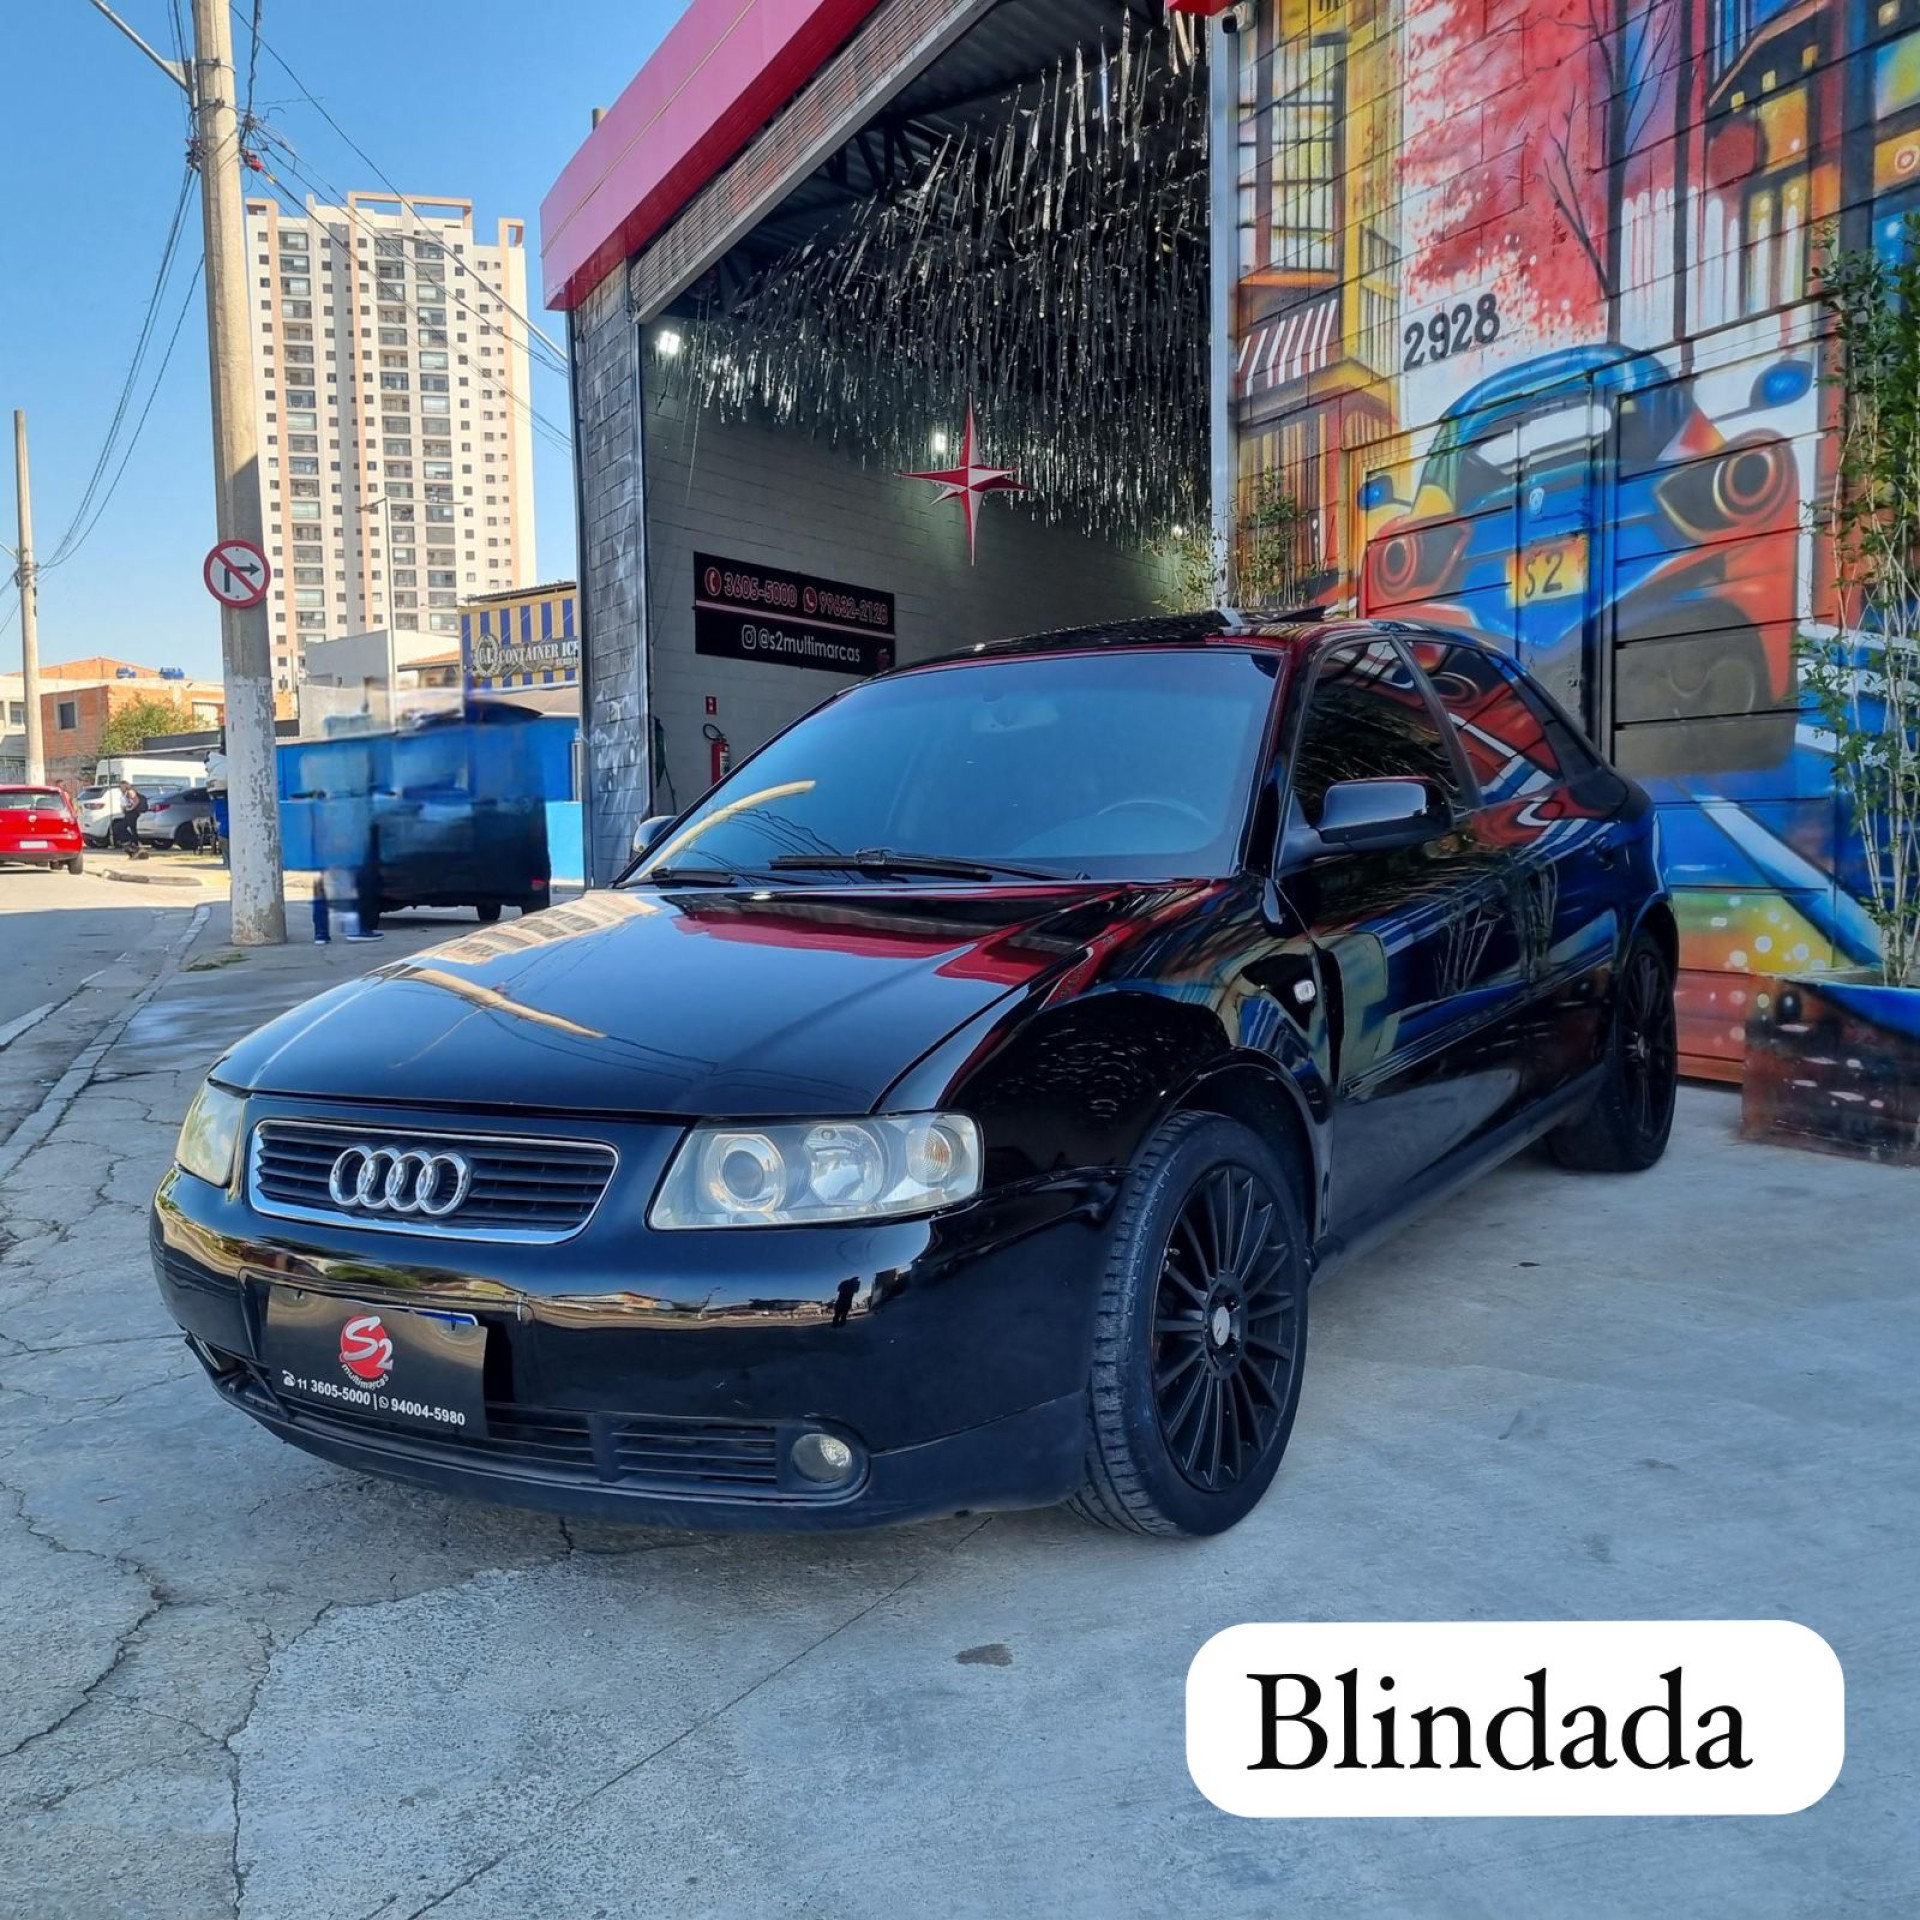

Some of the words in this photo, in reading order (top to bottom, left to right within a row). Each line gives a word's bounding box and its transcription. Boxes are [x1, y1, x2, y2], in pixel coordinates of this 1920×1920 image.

[1403, 293, 1501, 372] 2928
[724, 572, 798, 608] 3605-5000
[498, 644, 559, 664] CONTAINER
[758, 628, 861, 663] @s2multimarcas
[342, 1316, 394, 1371] S2
[297, 1378, 308, 1391] 11
[311, 1379, 371, 1405] 3605-5000
[391, 1398, 466, 1426] 94004-5980
